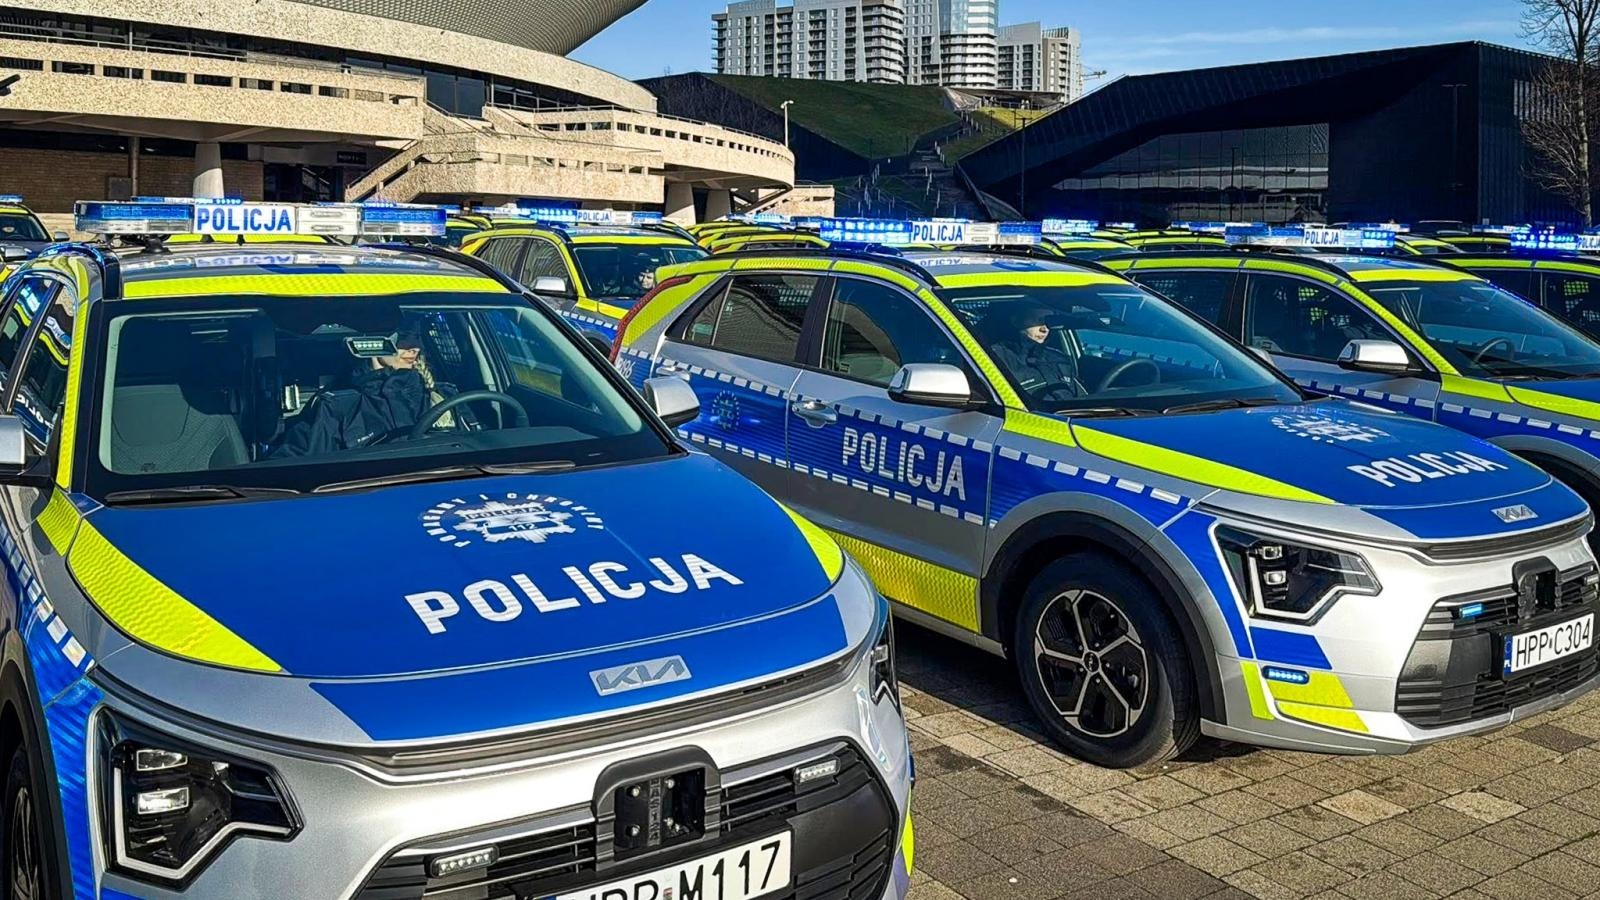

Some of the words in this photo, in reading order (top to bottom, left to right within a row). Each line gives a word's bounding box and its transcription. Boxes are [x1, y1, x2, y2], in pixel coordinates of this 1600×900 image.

[197, 207, 292, 231] POLICJA
[577, 211, 610, 221] POLICJA
[912, 223, 963, 242] POLICJA
[1304, 230, 1340, 244] POLICJA
[842, 426, 966, 501] POLICJA
[1346, 450, 1510, 487] POLICJA
[507, 522, 538, 534] 112
[404, 553, 745, 635] POLICJA
[1516, 632, 1550, 668] HPP
[1554, 618, 1592, 656] C304
[596, 657, 688, 694] KIA
[679, 840, 781, 900] M117
